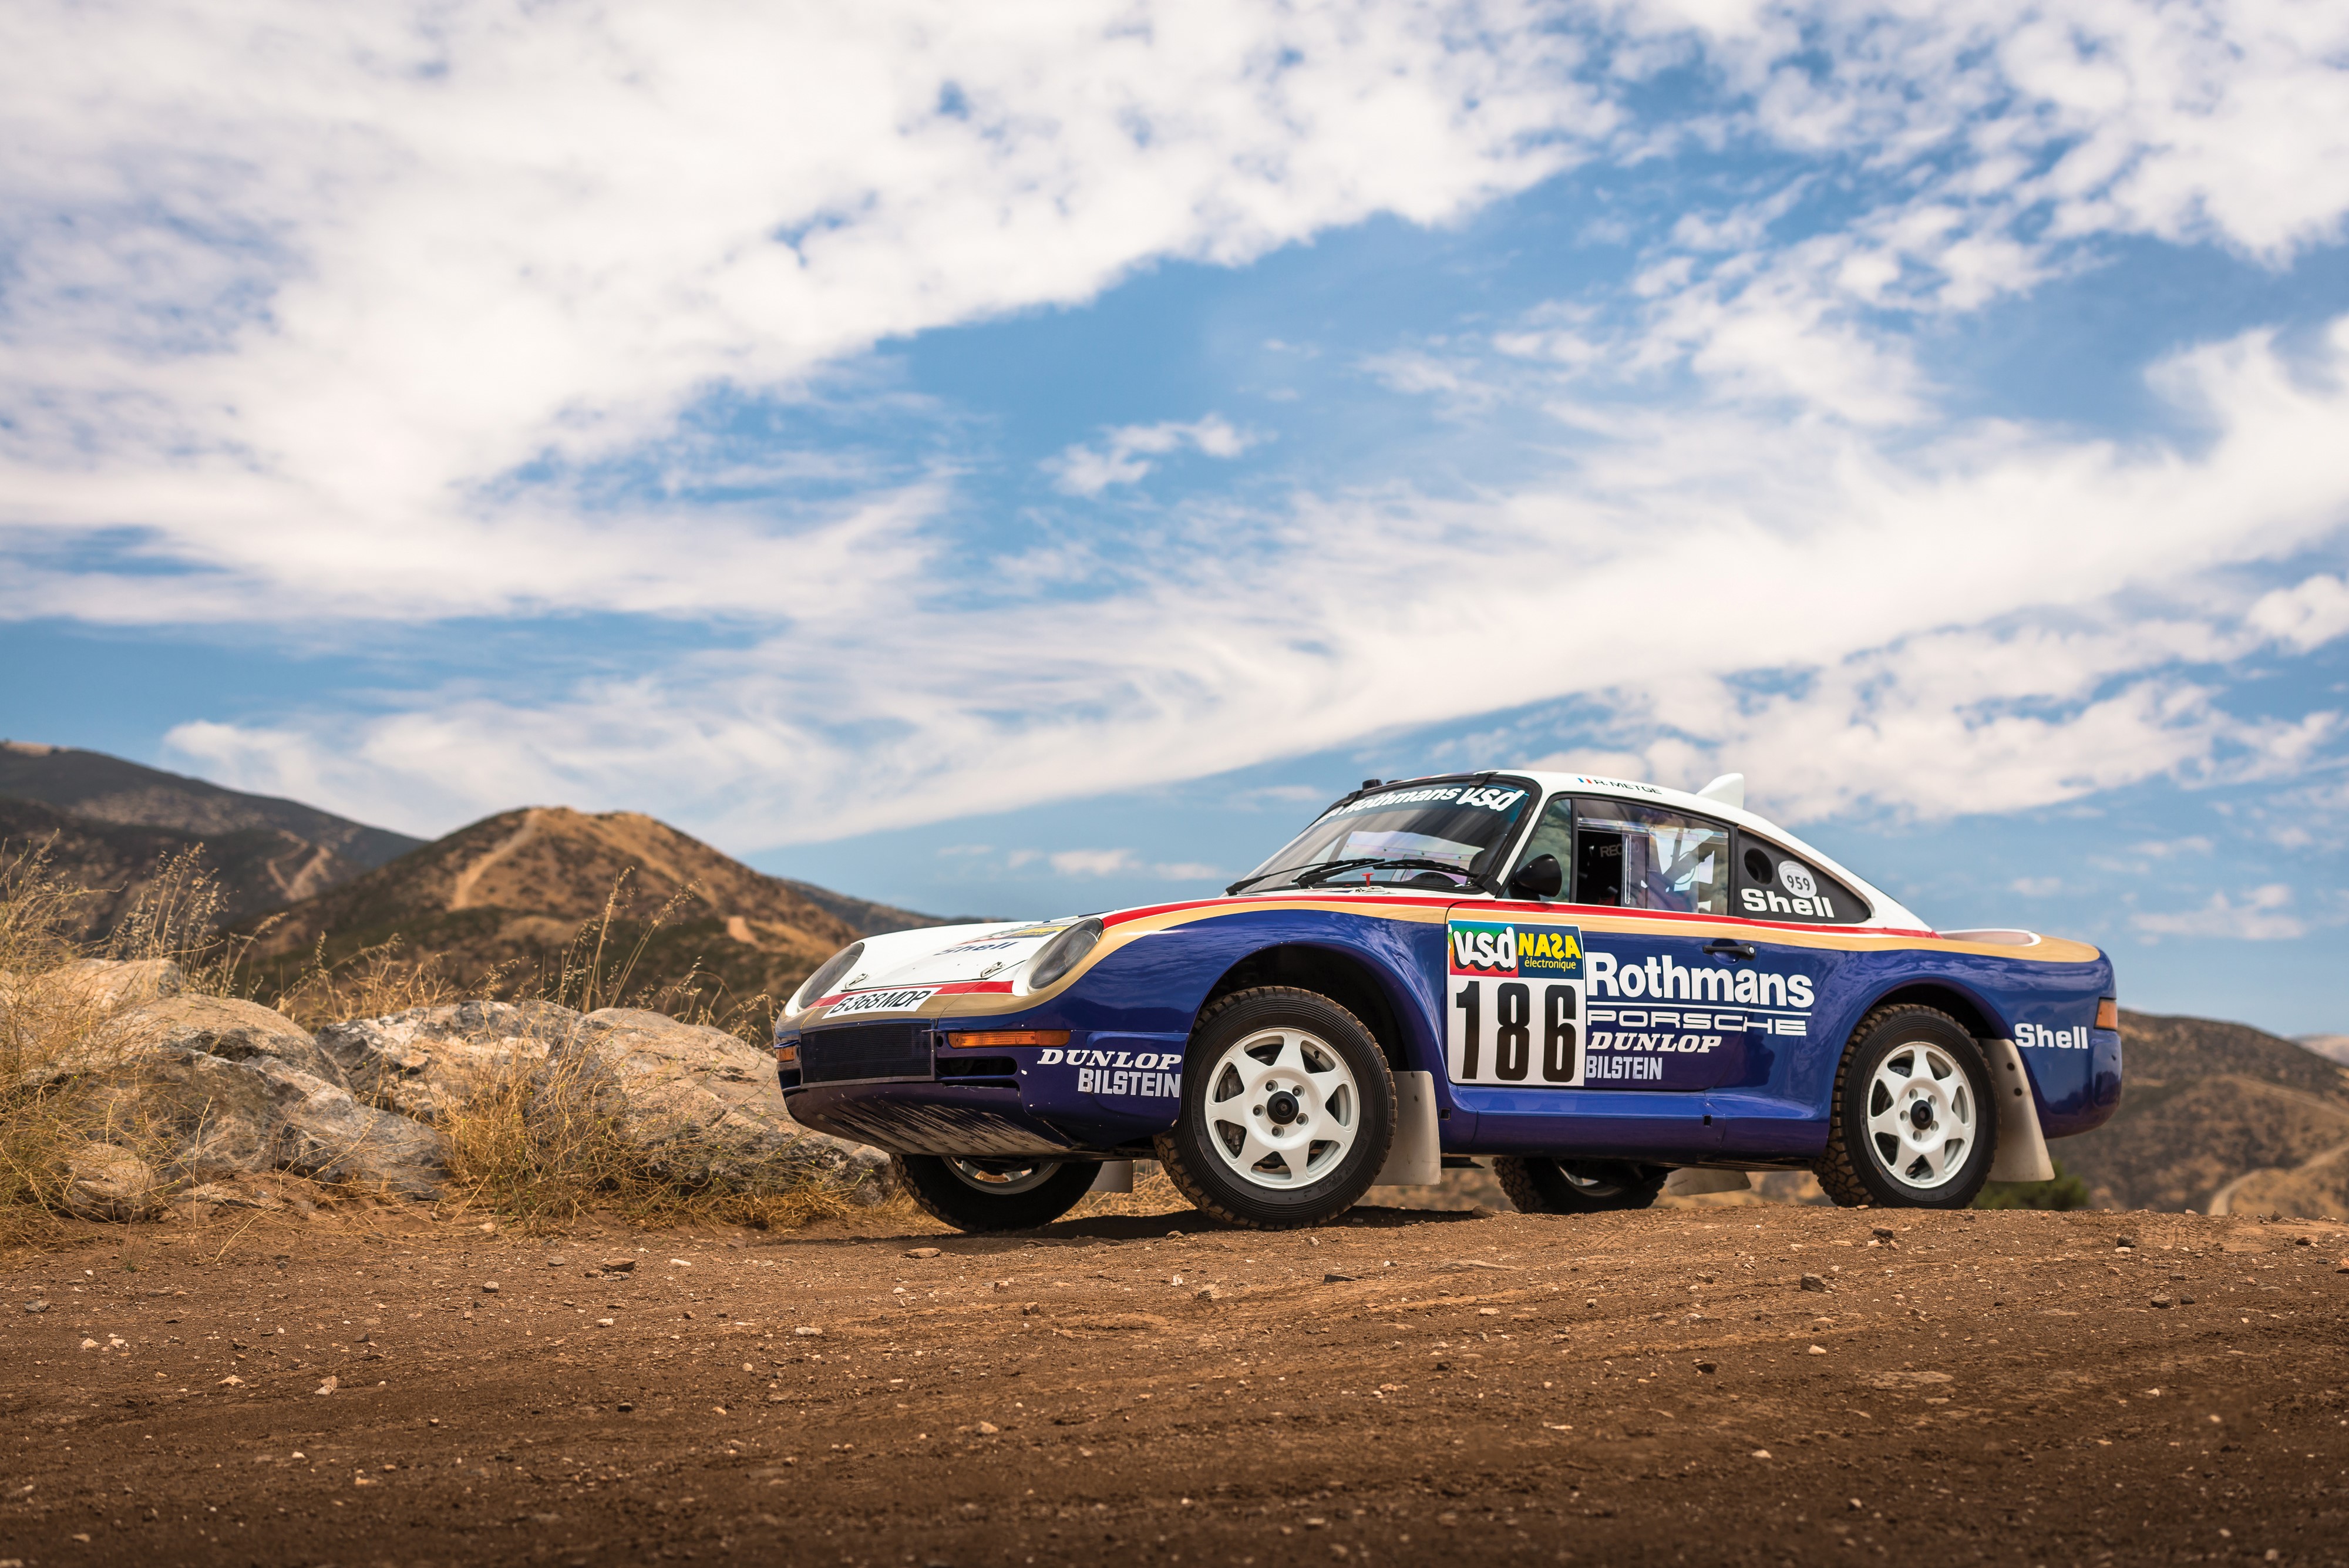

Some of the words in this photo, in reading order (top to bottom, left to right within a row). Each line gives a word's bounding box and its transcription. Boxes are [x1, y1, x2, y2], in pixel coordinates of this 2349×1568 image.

[1609, 781, 1662, 795] METGE
[1338, 788, 1462, 815] Rothmans
[1787, 875, 1810, 891] 959
[1741, 889, 1835, 918] Shell
[933, 941, 1019, 955] Shell
[1525, 957, 1576, 972] électronique
[1585, 952, 1815, 1008] Rothmans
[1456, 981, 1576, 1082] 186
[1587, 1010, 1807, 1036] PORSCHE
[1587, 1032, 1722, 1053] DUNLOP
[2014, 1023, 2088, 1049] Shell
[1037, 1049, 1182, 1069] DUNLOP
[1586, 1055, 1663, 1080] BILSTEIN
[1078, 1068, 1181, 1098] BILSTEIN
